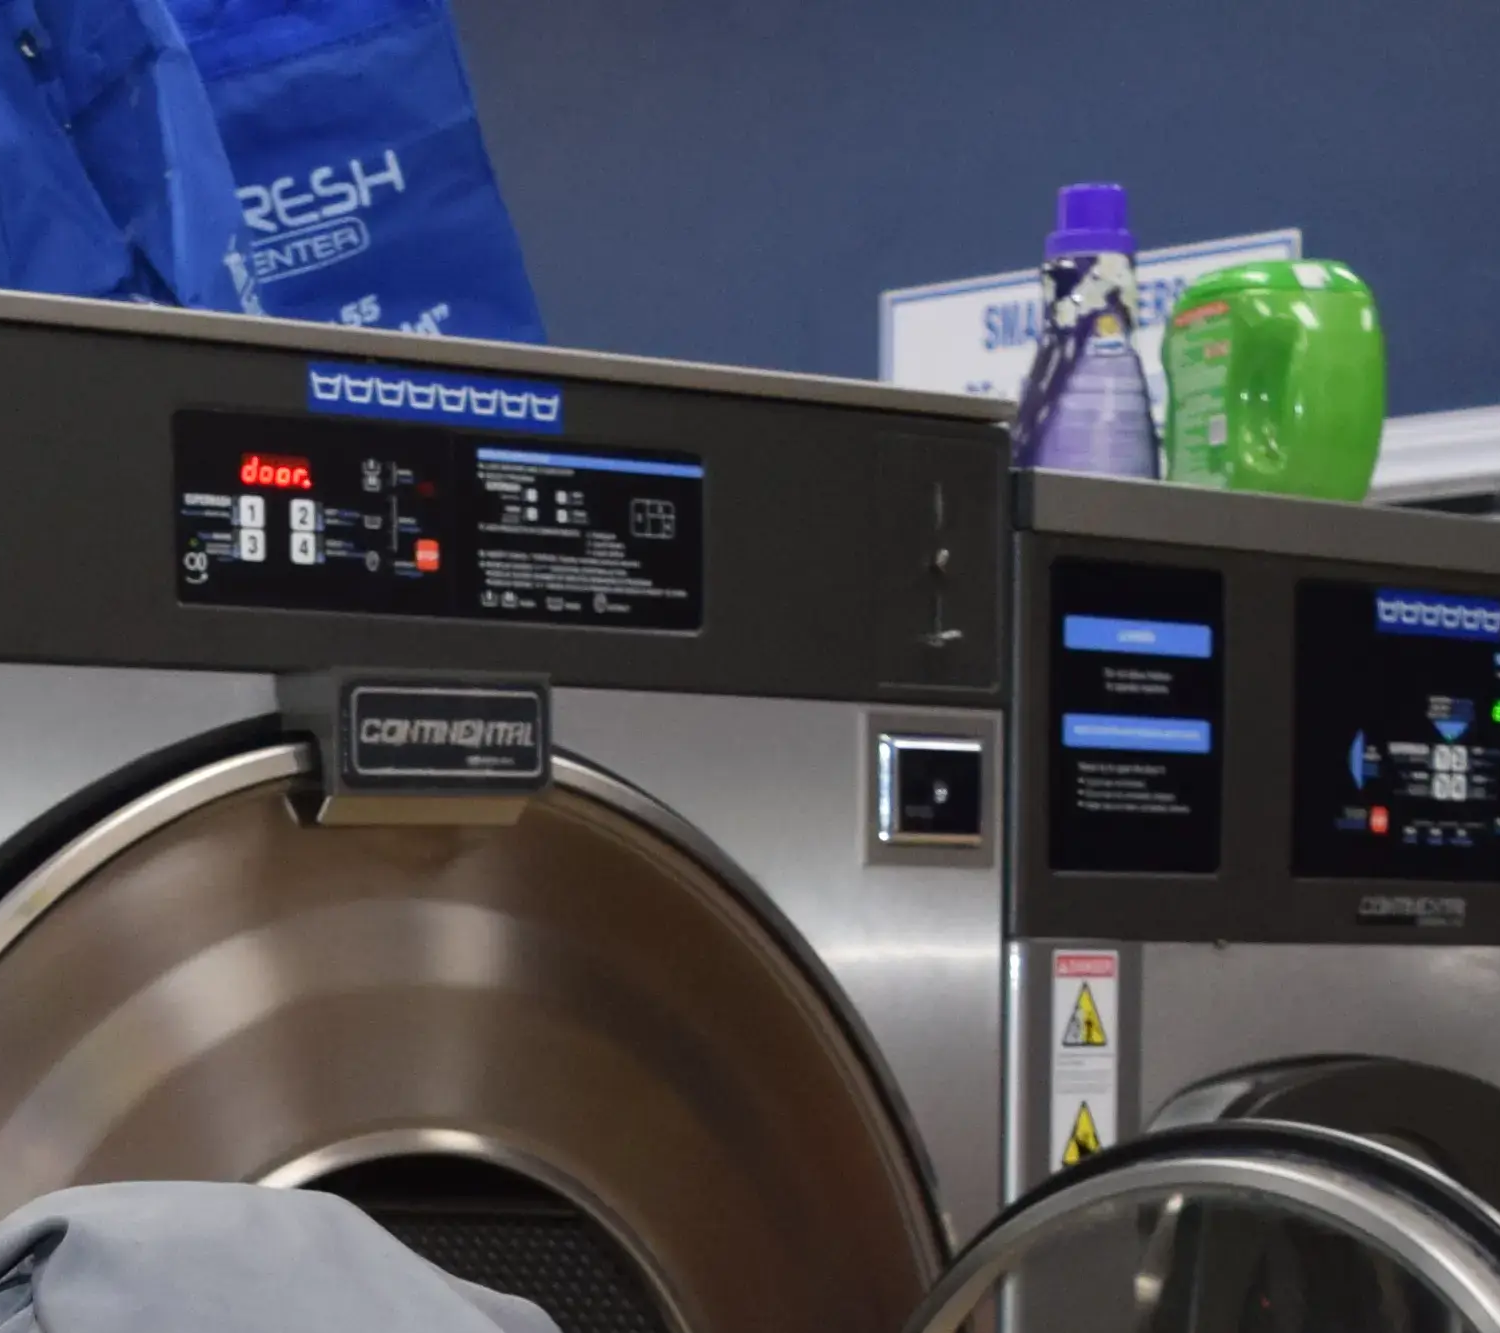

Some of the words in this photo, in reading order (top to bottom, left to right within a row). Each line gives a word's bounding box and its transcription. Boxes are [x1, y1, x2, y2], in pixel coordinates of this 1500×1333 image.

[234, 149, 406, 232] RESH
[253, 227, 360, 275] ENTER
[248, 504, 256, 521] 1
[299, 507, 308, 525] 2
[248, 534, 258, 554] 3
[300, 539, 308, 556] 4
[360, 719, 534, 747] CONTINENTAL
